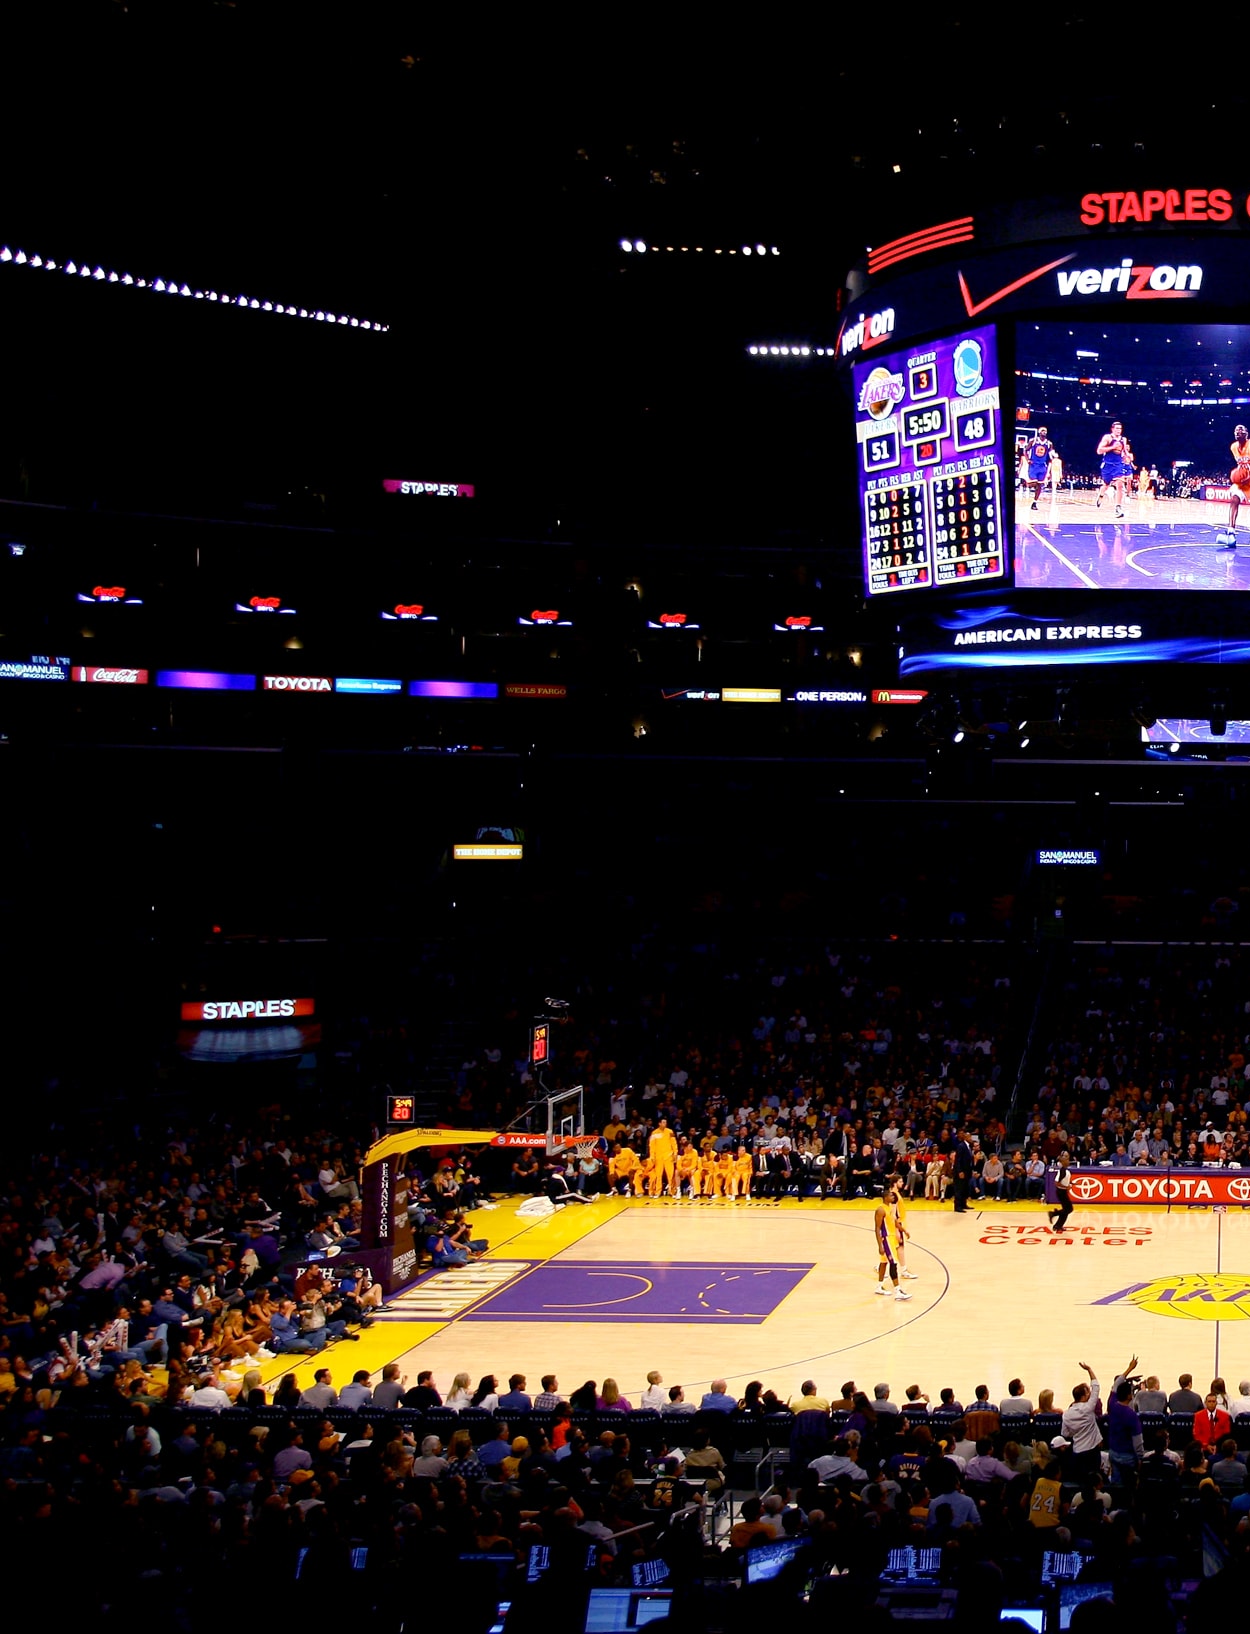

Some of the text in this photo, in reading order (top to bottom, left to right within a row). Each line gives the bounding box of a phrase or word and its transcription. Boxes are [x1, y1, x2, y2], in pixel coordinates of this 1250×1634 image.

[1081, 189, 1232, 226] STAPLES
[1057, 258, 1203, 300] verizon
[841, 305, 895, 357] verizon
[908, 352, 936, 368] QUARTER
[920, 373, 928, 388] 3
[909, 410, 941, 435] 5:50
[964, 418, 984, 439] 48
[872, 440, 890, 461] 51
[920, 444, 932, 458] 20
[913, 471, 923, 480] AST
[401, 480, 458, 496] STAPLES
[870, 485, 920, 506] 2 0 0 2 7
[870, 501, 921, 521] 9 10 2 5 0
[869, 518, 923, 537] 16 12 1 11 2
[870, 534, 923, 553] 17 3 1 12 0
[871, 550, 924, 570] 24 17 0 2 4
[890, 573, 896, 584] 1
[919, 570, 927, 582] 4
[954, 625, 1142, 645] AMERICAN EXPRESS
[23, 664, 64, 675] MANUEL
[93, 668, 138, 682] Coca-Cola
[265, 676, 332, 691] TOYOTA
[506, 686, 566, 696] WELLS FARGO
[687, 691, 720, 700] verizon
[796, 692, 818, 701] ONE
[456, 848, 522, 856] THE HOME DEPOT
[203, 1000, 296, 1020] STAPLES
[534, 1040, 545, 1060] 20
[396, 1099, 412, 1108] 5:49
[393, 1108, 410, 1120] 20
[510, 1136, 546, 1146] AAA.com
[1108, 1179, 1212, 1199] TOYOTA
[984, 1226, 1152, 1235] STAPLES
[978, 1235, 1151, 1246] Center
[1032, 1494, 1055, 1512] 24
